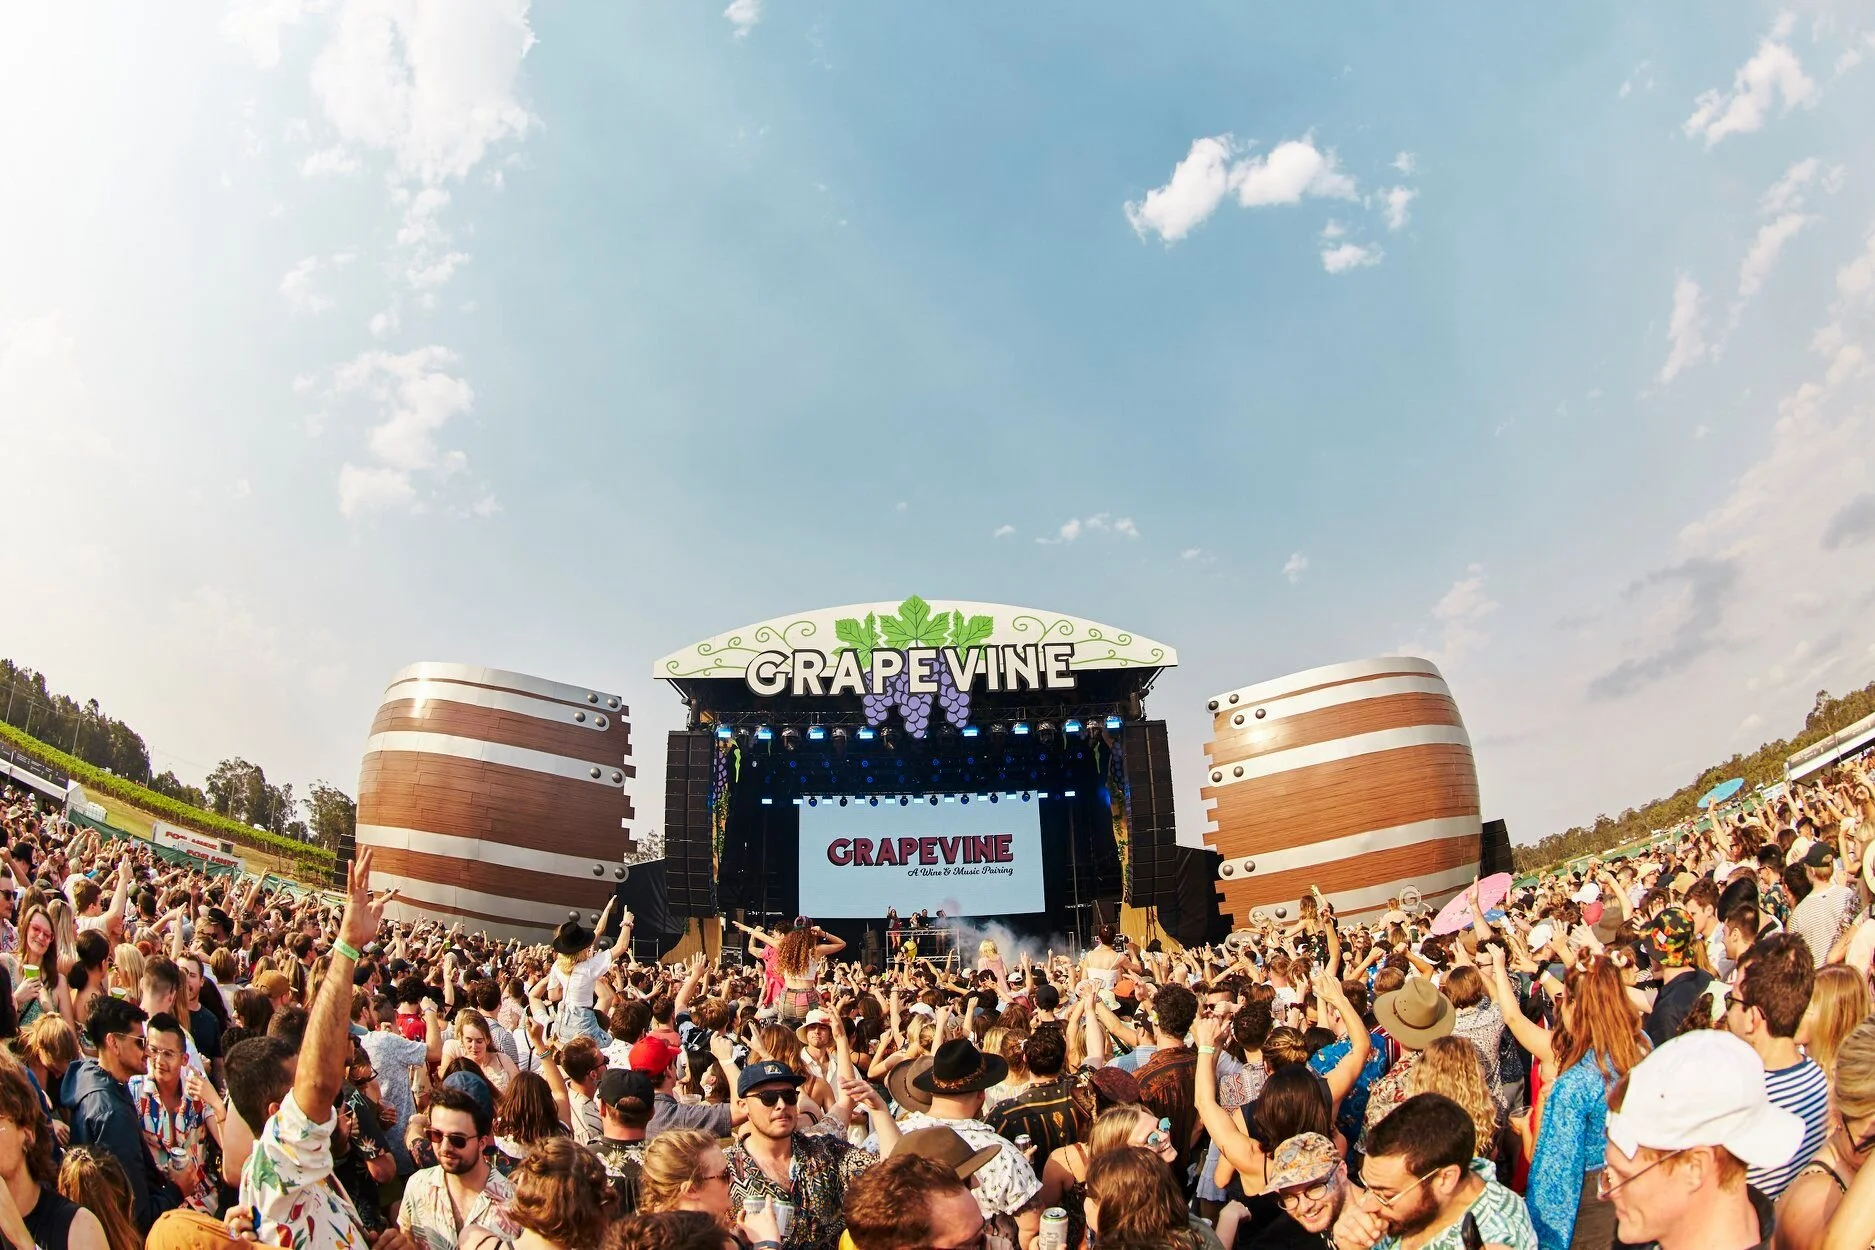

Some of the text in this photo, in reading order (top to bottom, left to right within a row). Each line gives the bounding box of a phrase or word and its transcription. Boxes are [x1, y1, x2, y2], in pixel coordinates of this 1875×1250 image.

[745, 643, 1078, 697] GRAPEVINE
[827, 834, 1014, 866] GRAPEVINE
[907, 865, 1014, 877] A Wine & Music Pairing
